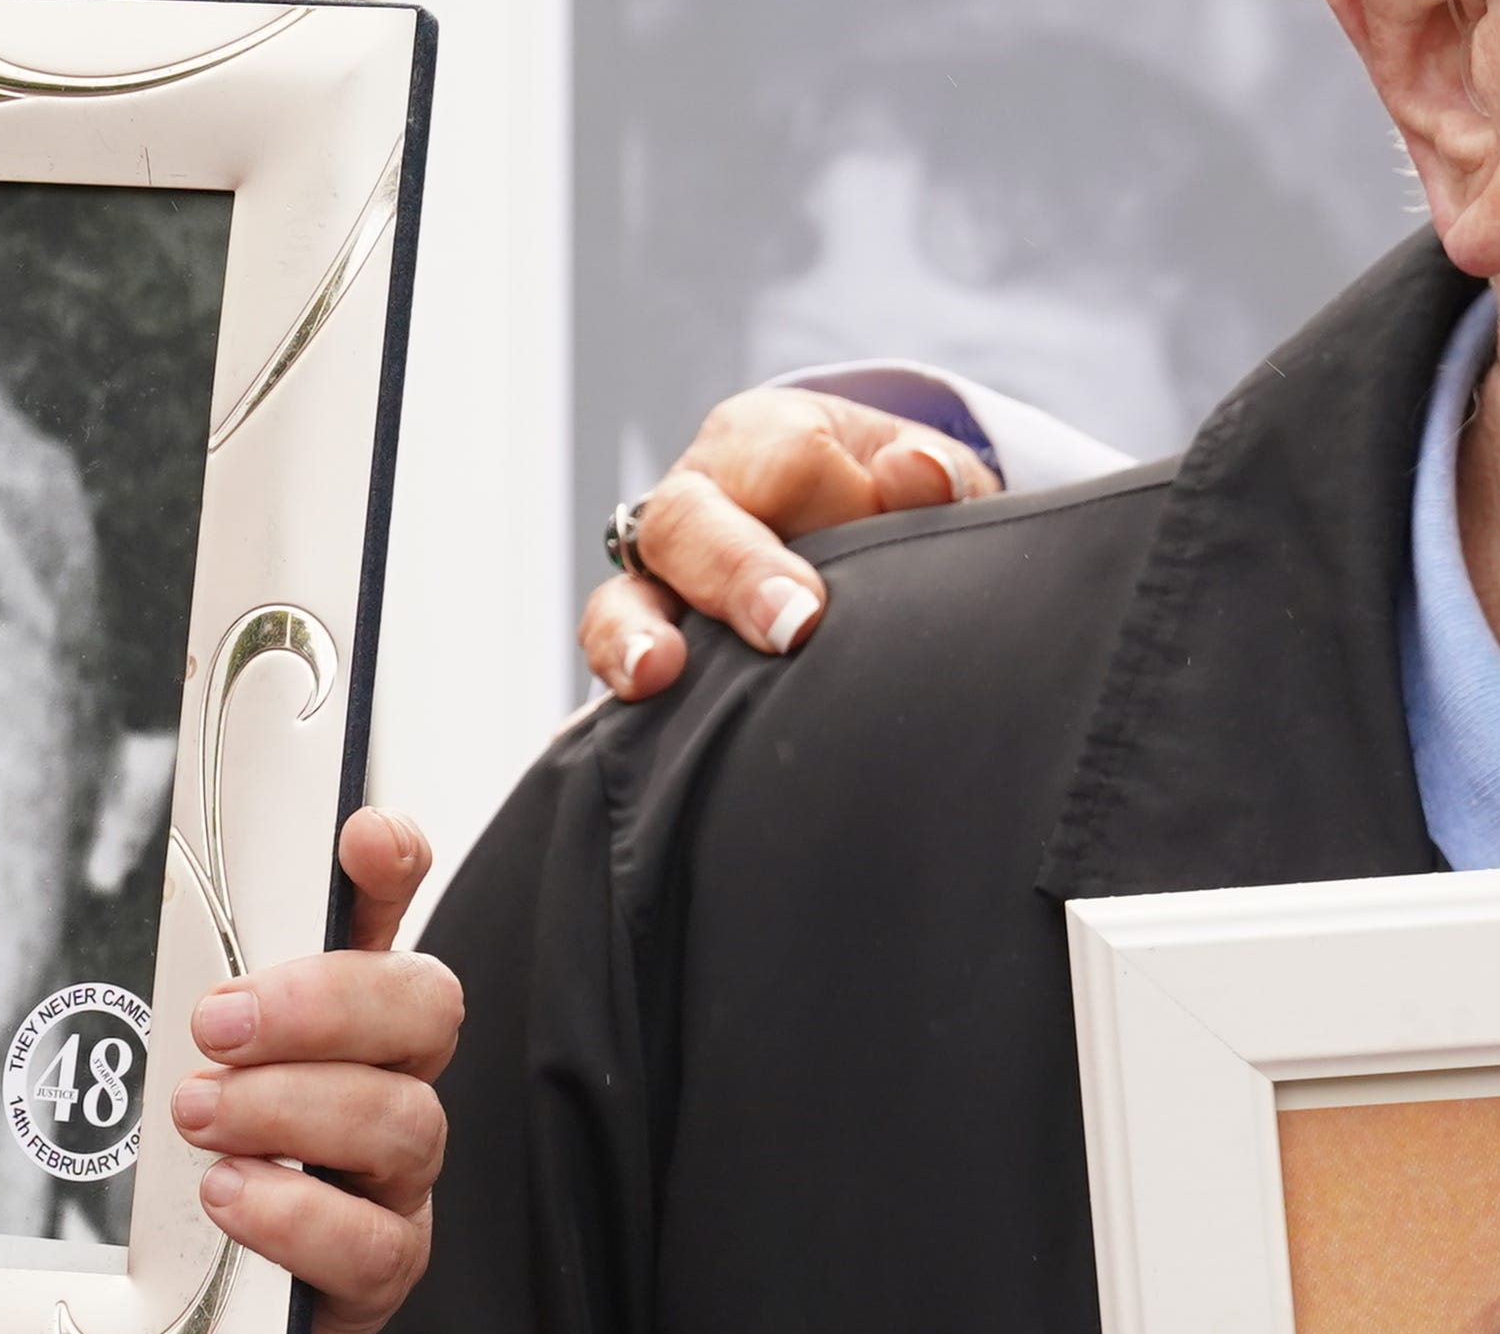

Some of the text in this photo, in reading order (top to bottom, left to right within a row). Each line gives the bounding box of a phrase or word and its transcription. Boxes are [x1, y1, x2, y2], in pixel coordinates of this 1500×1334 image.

[10, 987, 151, 1072] THEY NEVER CAME
[34, 1033, 133, 1127] 48
[36, 1087, 75, 1100] JUSTICE
[93, 1058, 123, 1102] STARDUST
[9, 1095, 142, 1176] 14th FEBRUARY 19
